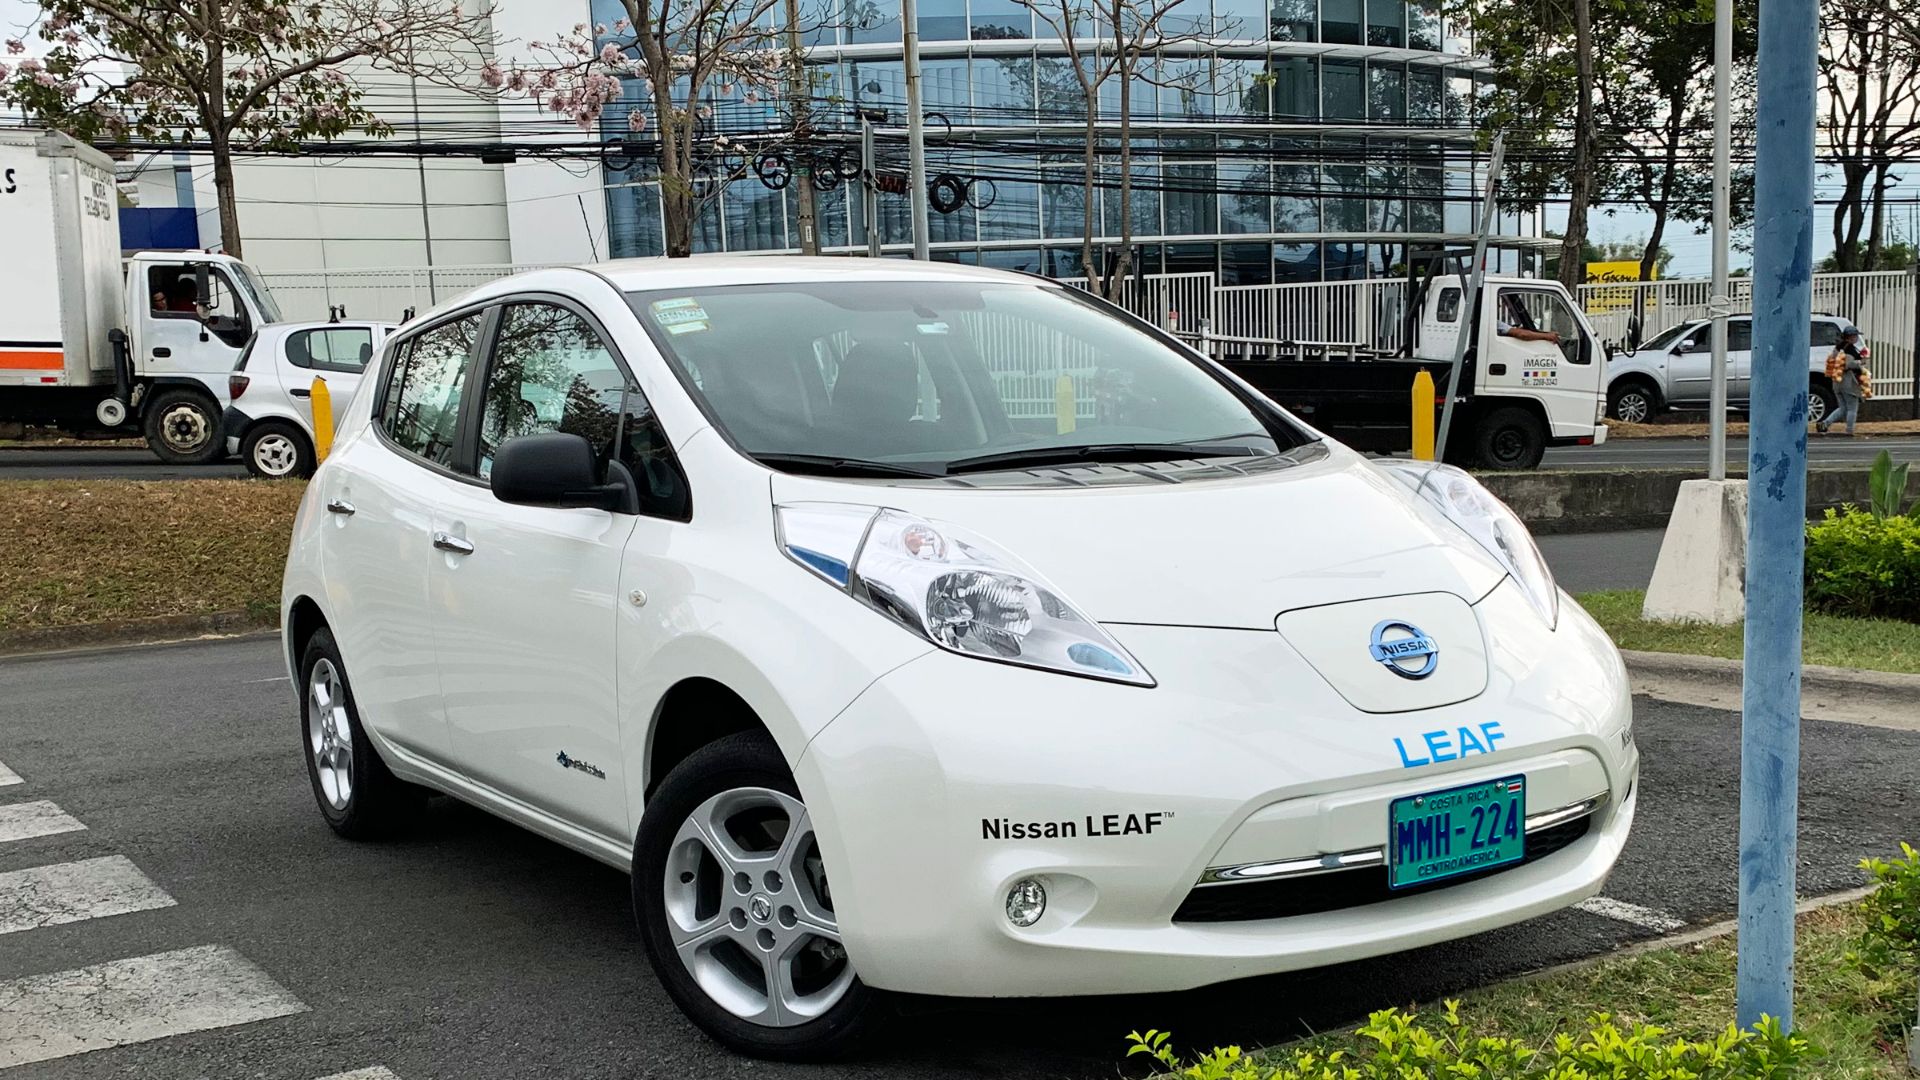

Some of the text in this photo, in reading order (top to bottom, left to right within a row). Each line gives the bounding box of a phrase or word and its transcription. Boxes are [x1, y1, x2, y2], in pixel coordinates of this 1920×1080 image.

[1381, 639, 1435, 656] NISSAN
[1393, 721, 1505, 768] LEAF
[1430, 789, 1490, 811] COSTA RICA
[981, 818, 1077, 840] Nissan
[1397, 798, 1518, 865] MMH-224
[1418, 849, 1501, 877] CENTROAMERICA
